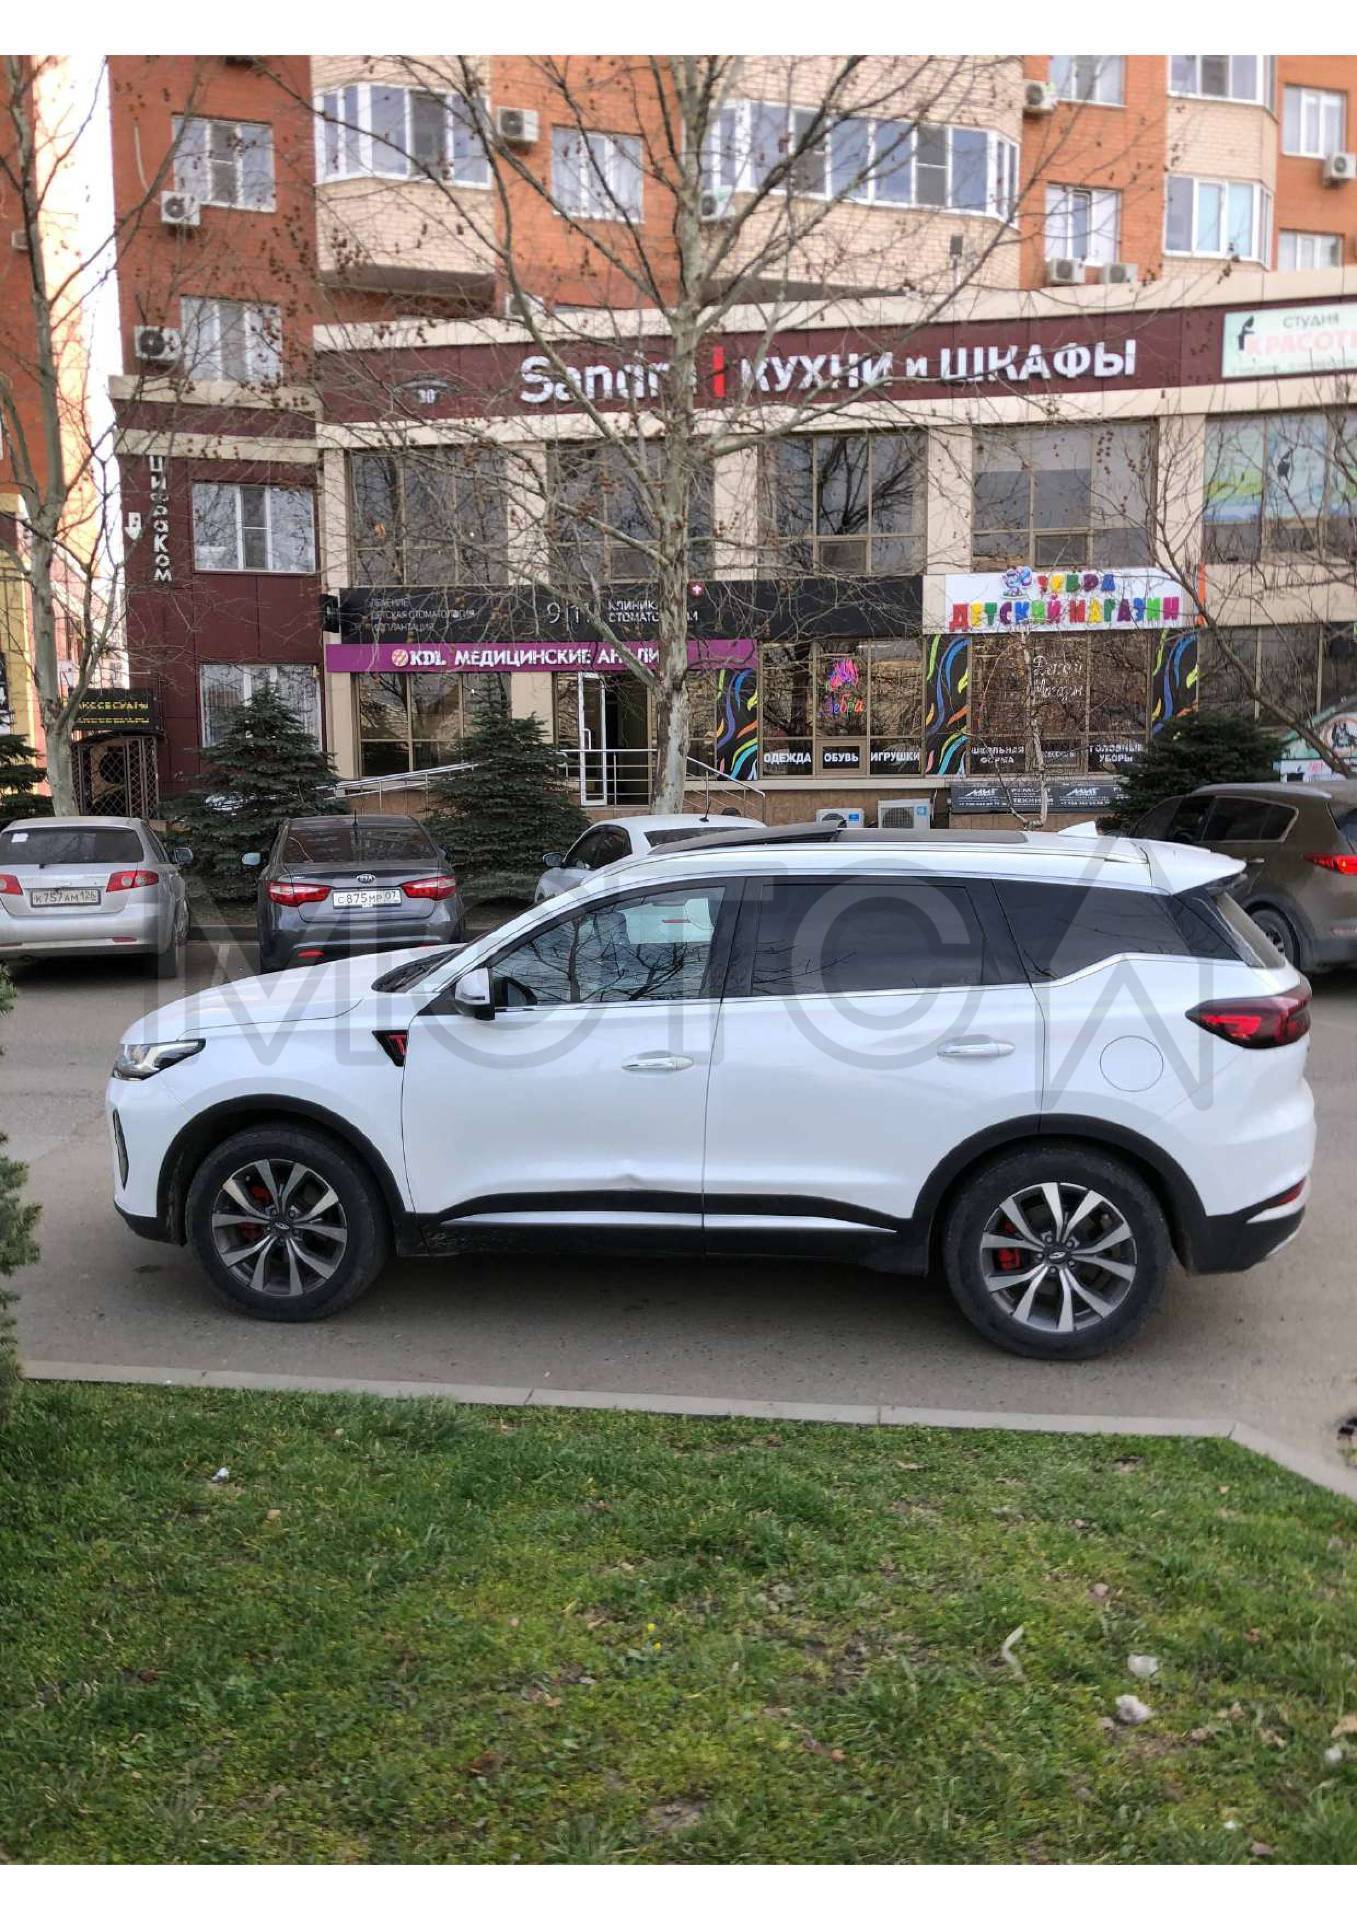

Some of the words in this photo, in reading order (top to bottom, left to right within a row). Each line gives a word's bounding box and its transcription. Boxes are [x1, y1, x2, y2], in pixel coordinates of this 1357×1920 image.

[740, 352, 894, 392] КУХНИ
[940, 339, 1136, 382] ШКАФЫ
[949, 600, 1061, 632] ДЕТСКИЙ
[1069, 597, 1180, 623] МАГАЗИН
[455, 650, 591, 667] МЕДИЦИНСКИЕ
[763, 752, 812, 764] ОДЕЖДА
[824, 752, 859, 763] ОБУВЬ
[870, 751, 920, 762] ИГРУШКИ
